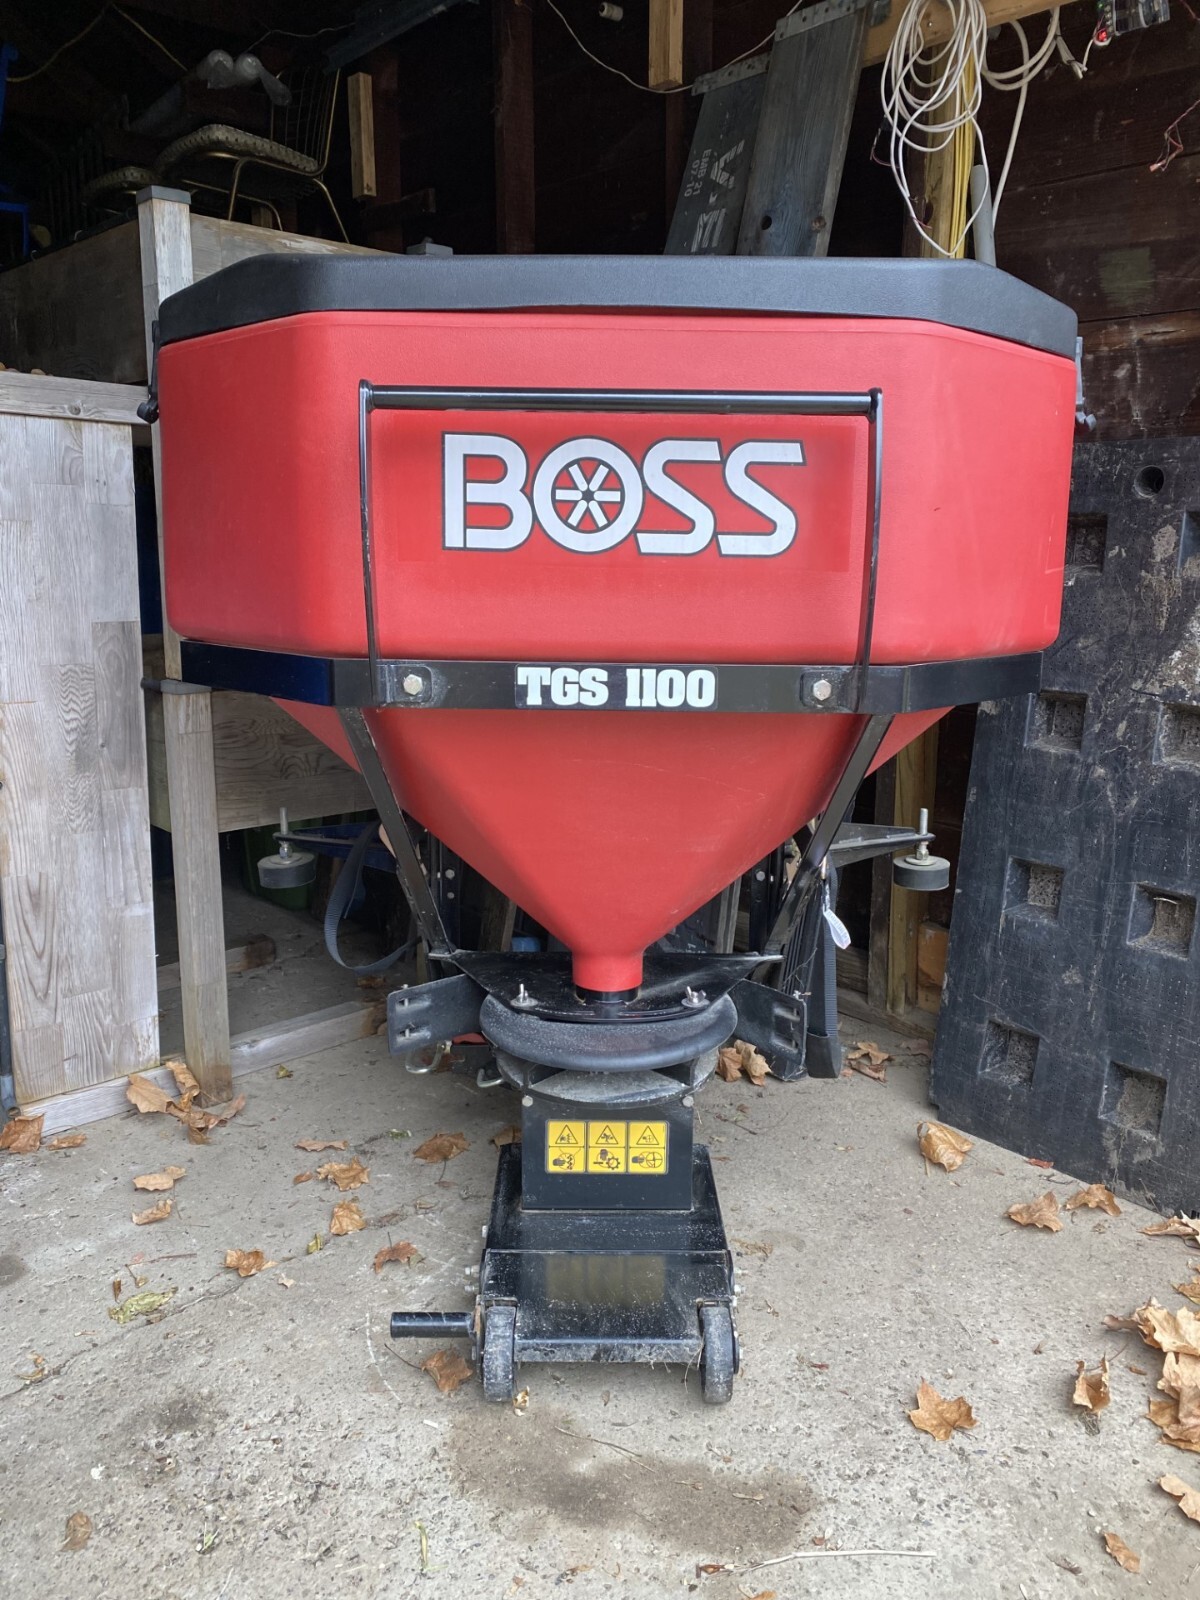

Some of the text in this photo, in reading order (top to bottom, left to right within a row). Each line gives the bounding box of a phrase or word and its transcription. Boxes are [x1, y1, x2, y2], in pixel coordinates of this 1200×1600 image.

[441, 431, 807, 558] BOSS
[517, 666, 716, 708] TGS 1100
